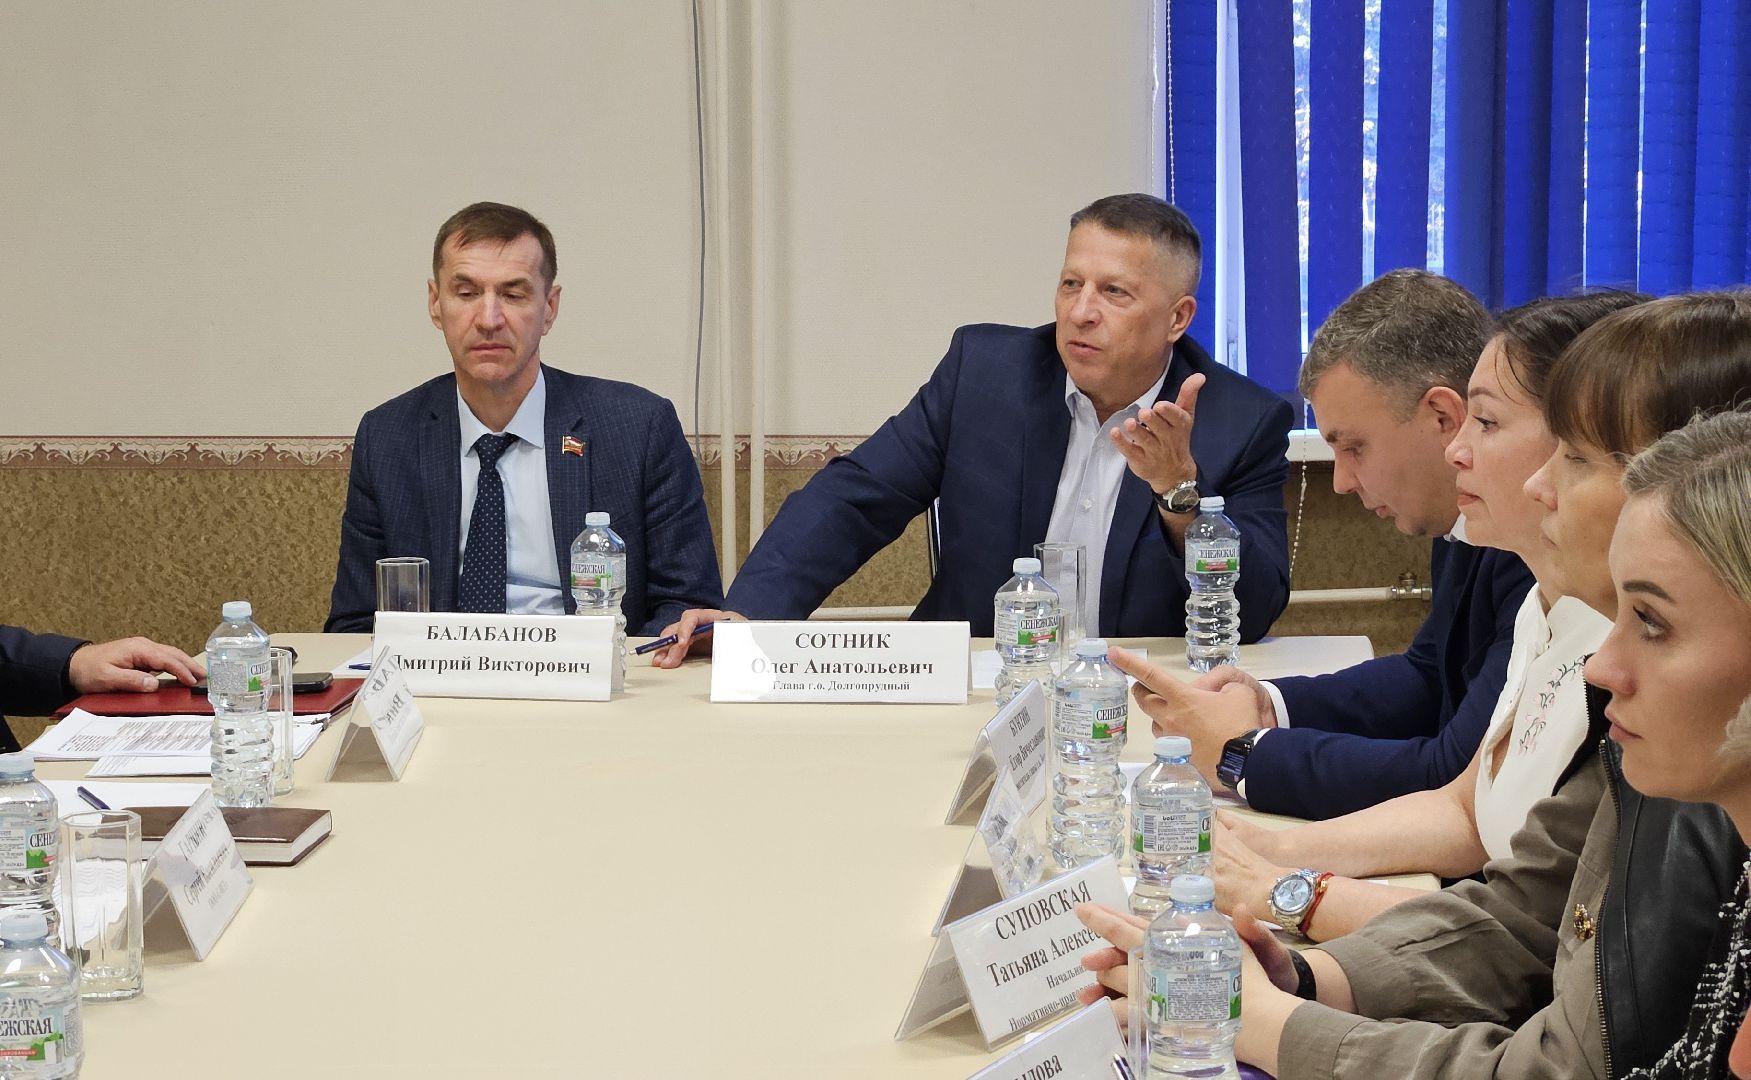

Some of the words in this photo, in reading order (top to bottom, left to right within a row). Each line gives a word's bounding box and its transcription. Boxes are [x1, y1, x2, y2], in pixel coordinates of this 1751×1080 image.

[427, 625, 557, 643] БАЛАБАНОВ
[795, 632, 891, 649] СОТНИК
[478, 655, 591, 677] Викторович
[803, 658, 934, 675] Анатольевич
[773, 680, 805, 691] Глава
[828, 680, 910, 693] Долгопрудный
[995, 880, 1092, 940] СУПОВСКАЯ
[986, 948, 1049, 988] Татьяна
[1050, 928, 1101, 961] Алексе
[1046, 964, 1087, 990] Начальни
